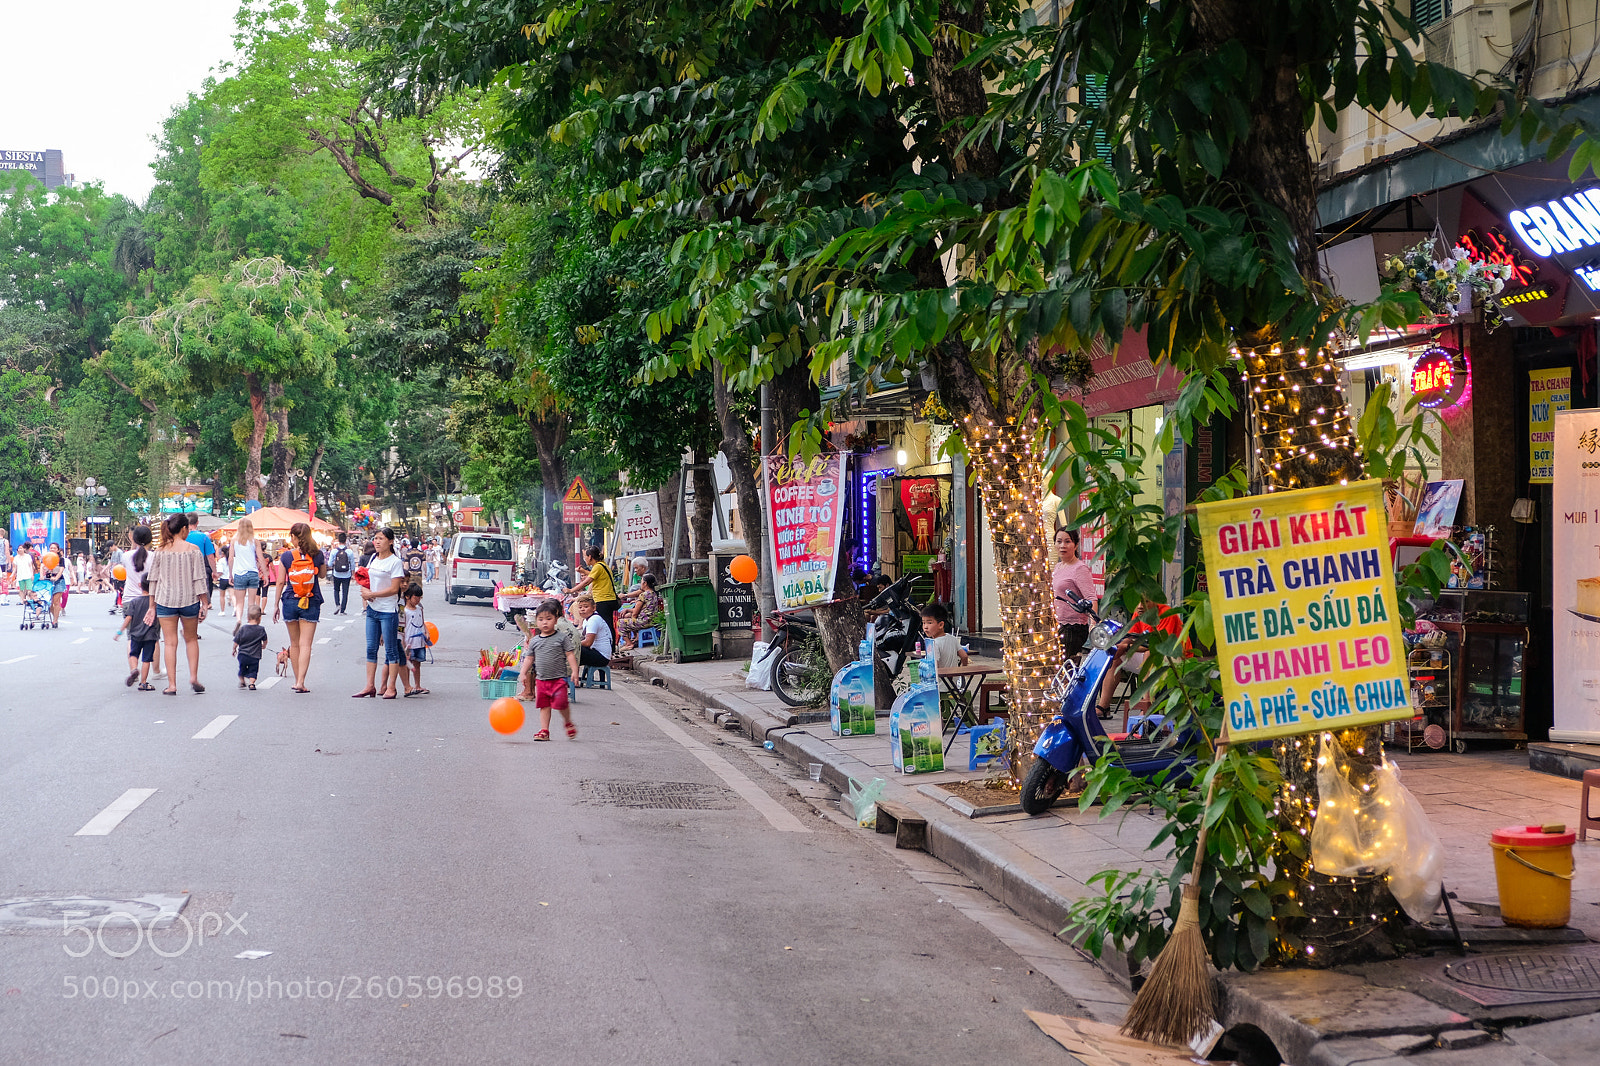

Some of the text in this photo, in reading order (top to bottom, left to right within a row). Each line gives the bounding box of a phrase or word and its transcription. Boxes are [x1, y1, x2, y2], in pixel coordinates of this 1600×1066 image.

[5, 151, 44, 161] SIESTA
[774, 486, 815, 504] COFFEE
[627, 511, 652, 527] PHỞ
[776, 499, 832, 528] SINH TỐ
[1564, 512, 1587, 523] MUA
[624, 526, 658, 541] THÌN
[795, 526, 806, 541] ÉP
[1218, 502, 1368, 555] GIẢI KHÁT
[792, 542, 806, 557] CÂY
[799, 559, 827, 572] Juice
[1219, 549, 1381, 599] TRÀ CHANH
[804, 574, 824, 595] ĐÁ
[728, 606, 743, 618] 63
[1224, 611, 1259, 643] ME
[1263, 600, 1295, 638] ĐÁ
[1308, 589, 1351, 632] SẤU
[1357, 587, 1388, 625] ĐÁ
[1233, 635, 1391, 684] CHANH LEO
[1229, 694, 1257, 730] CÀ
[1261, 688, 1299, 726] PHÊ
[1311, 681, 1351, 719] SỮA
[1354, 679, 1407, 713] CHUA
